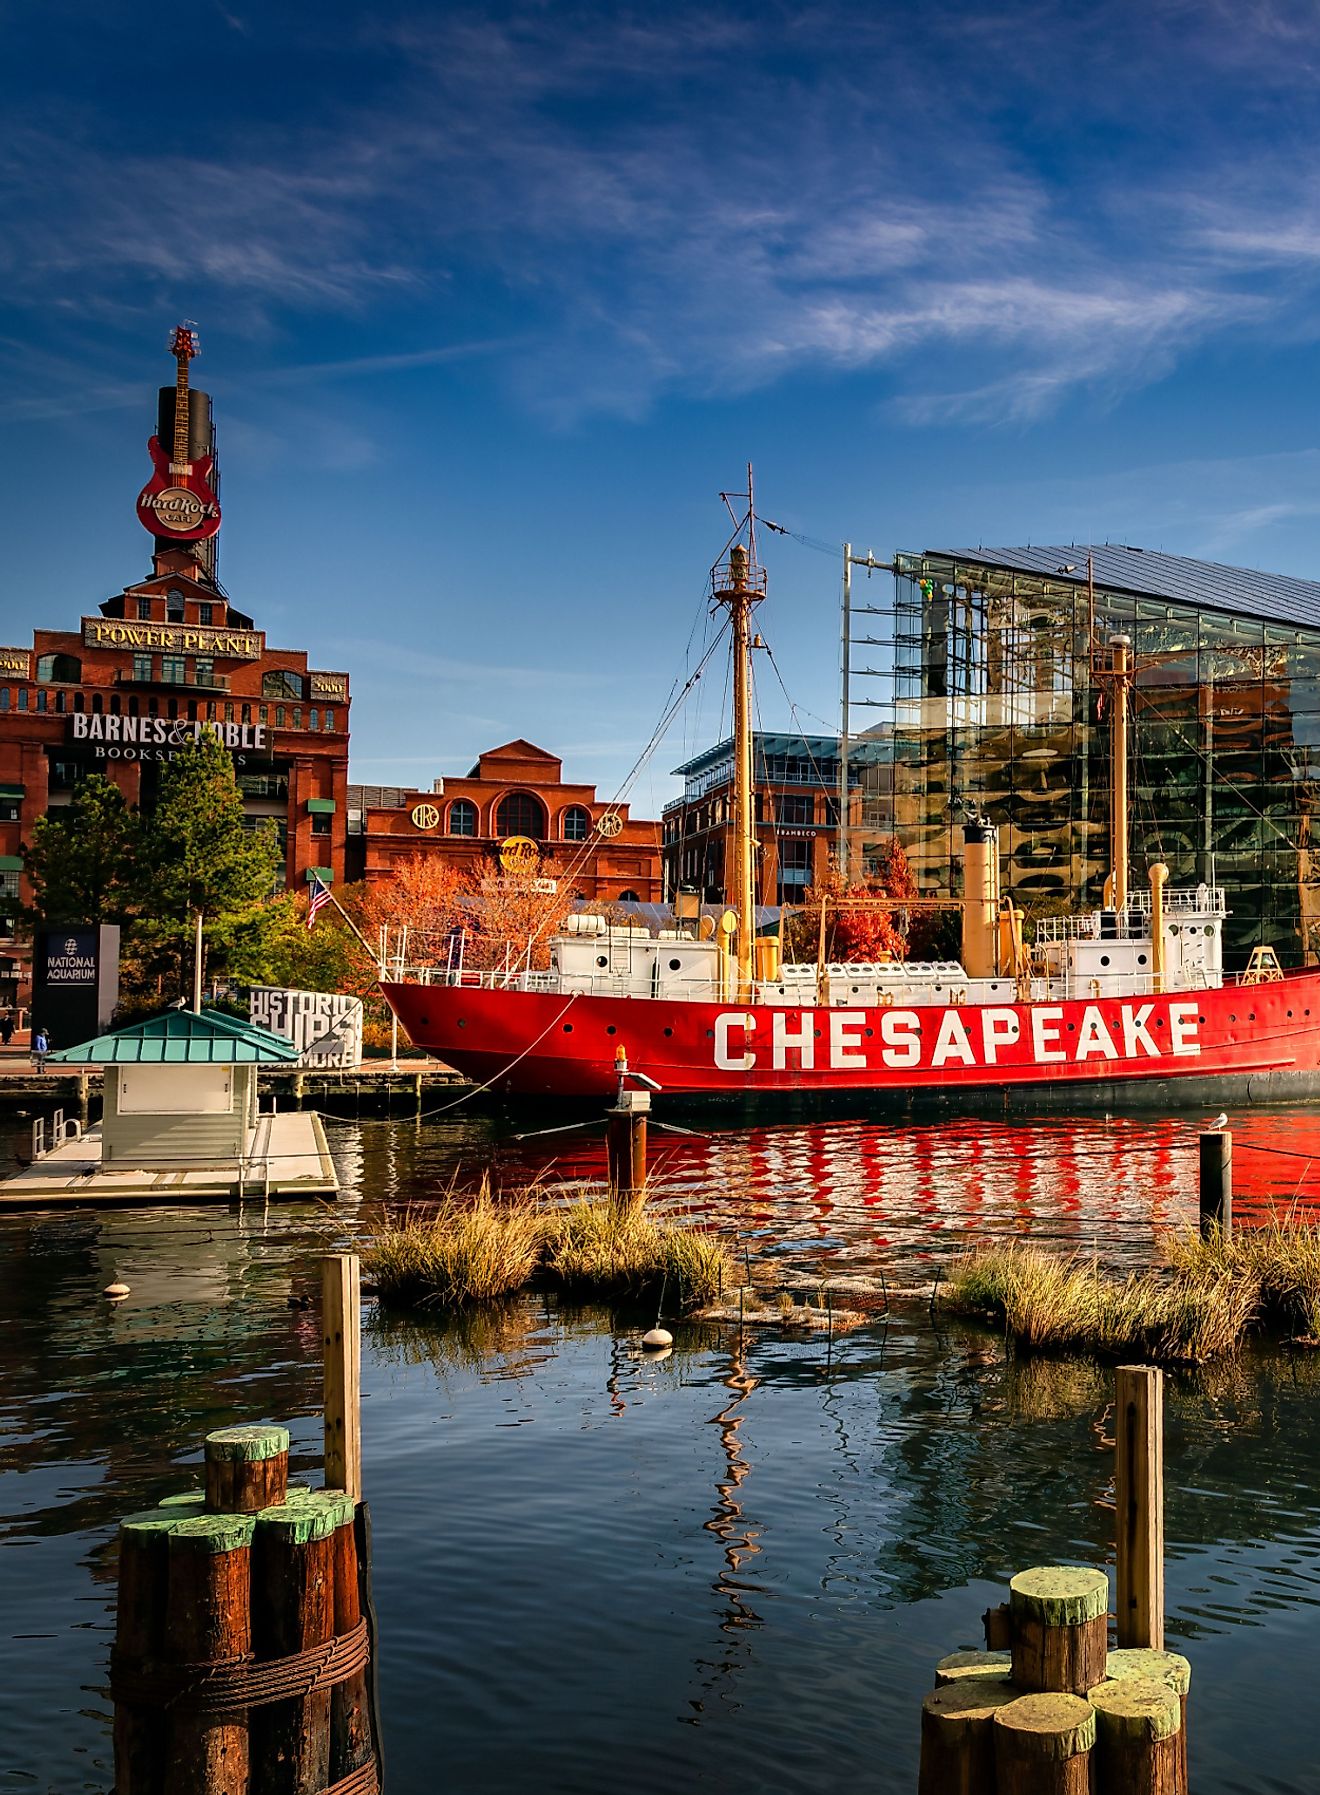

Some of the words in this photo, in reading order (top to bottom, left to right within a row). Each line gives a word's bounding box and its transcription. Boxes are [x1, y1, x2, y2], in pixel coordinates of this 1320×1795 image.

[140, 494, 178, 511] Hard
[180, 498, 219, 518] Rock
[165, 513, 193, 523] CAFE
[94, 625, 174, 648] POWER
[182, 632, 255, 654] PLANT
[313, 680, 343, 693] 2000
[95, 746, 247, 767] BOOKSES
[47, 956, 96, 968] NATIONAL
[46, 968, 96, 980] AQUARIUM
[250, 991, 353, 1015] HISTORIC
[713, 1002, 1201, 1071] CHESAPEAKE
